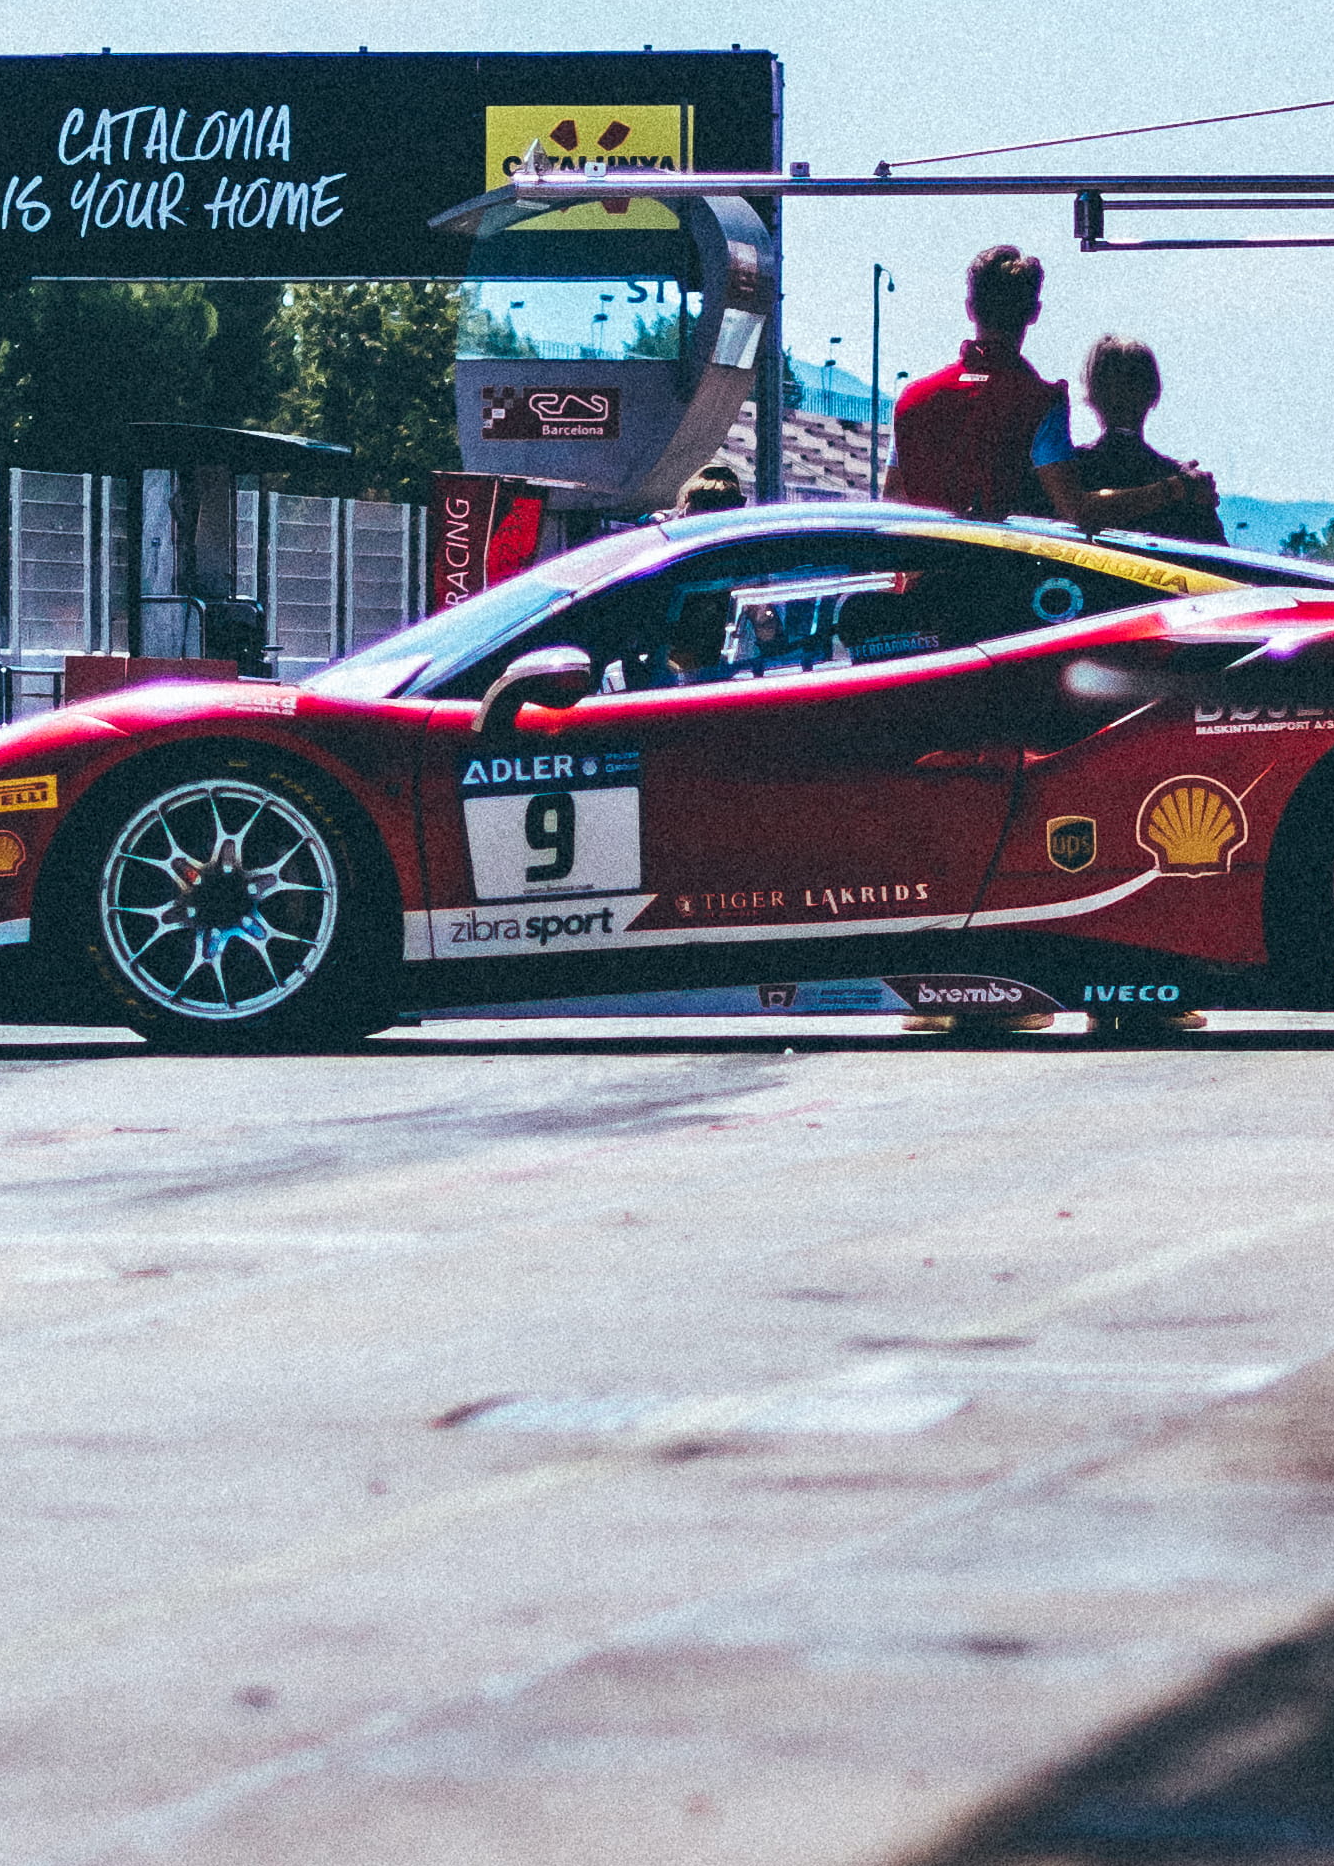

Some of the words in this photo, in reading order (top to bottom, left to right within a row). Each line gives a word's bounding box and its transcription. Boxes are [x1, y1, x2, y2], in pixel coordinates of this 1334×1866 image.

[58, 105, 290, 165] CATALONIA
[2, 176, 52, 232] IS
[70, 172, 187, 238] YOUR
[203, 173, 348, 233] HOME
[542, 425, 604, 436] Barcelona
[445, 497, 470, 605] RACING
[1034, 542, 1189, 594] SINGHA
[1196, 721, 1310, 735] MASKINTRANSPORT
[1314, 720, 1334, 731] A/S
[462, 755, 574, 785] ADLER
[525, 792, 576, 883] 9
[1052, 835, 1092, 862] ups
[703, 891, 785, 910] TIGER
[805, 883, 929, 914] LAKRIDS
[451, 910, 521, 943] zibra
[525, 907, 614, 946] sport
[918, 982, 1022, 1003] brembo
[1083, 984, 1179, 1002] IVECO
